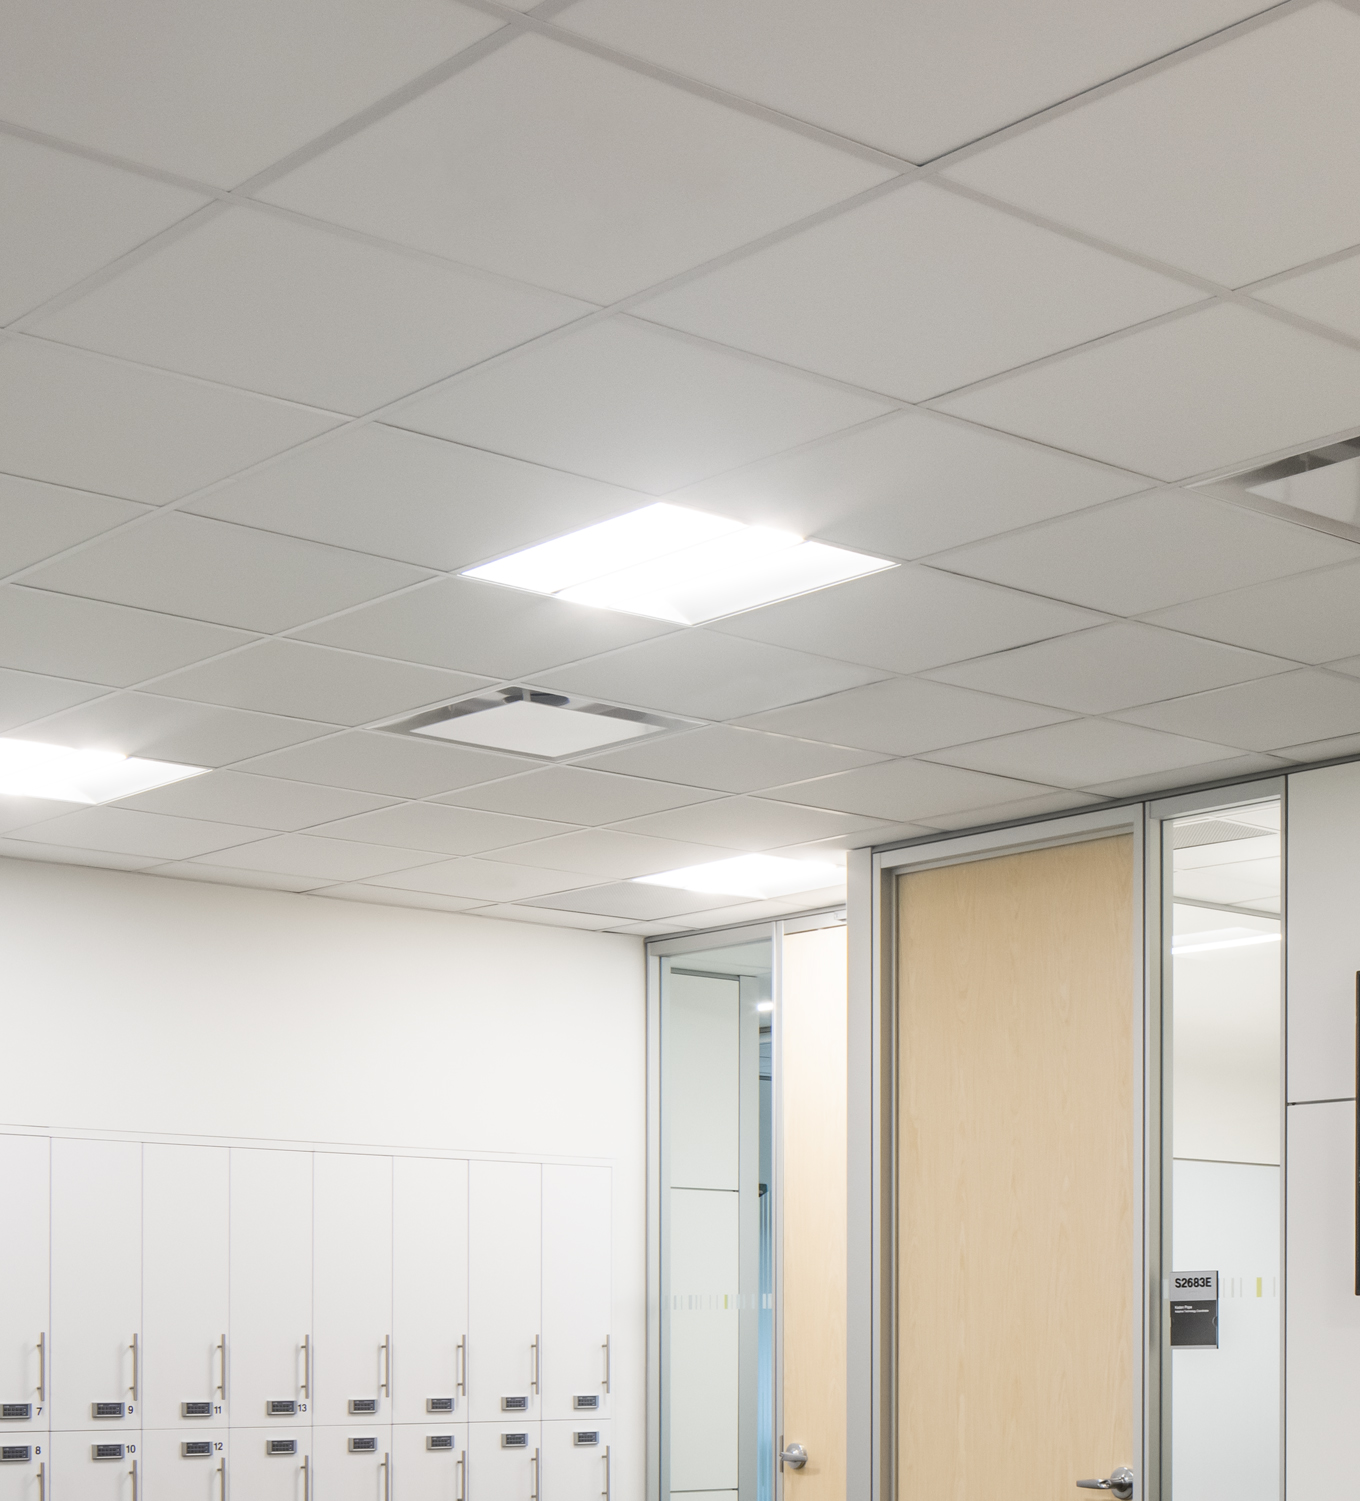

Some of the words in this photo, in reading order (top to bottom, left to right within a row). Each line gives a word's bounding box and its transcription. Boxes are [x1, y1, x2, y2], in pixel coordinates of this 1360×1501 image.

[1175, 1277, 1211, 1288] S2683E
[37, 1407, 42, 1415] 7
[128, 1406, 133, 1414] 9
[298, 1404, 306, 1412] 13
[36, 1446, 41, 1454] 8
[126, 1445, 135, 1453] 10
[214, 1442, 223, 1450] 12
